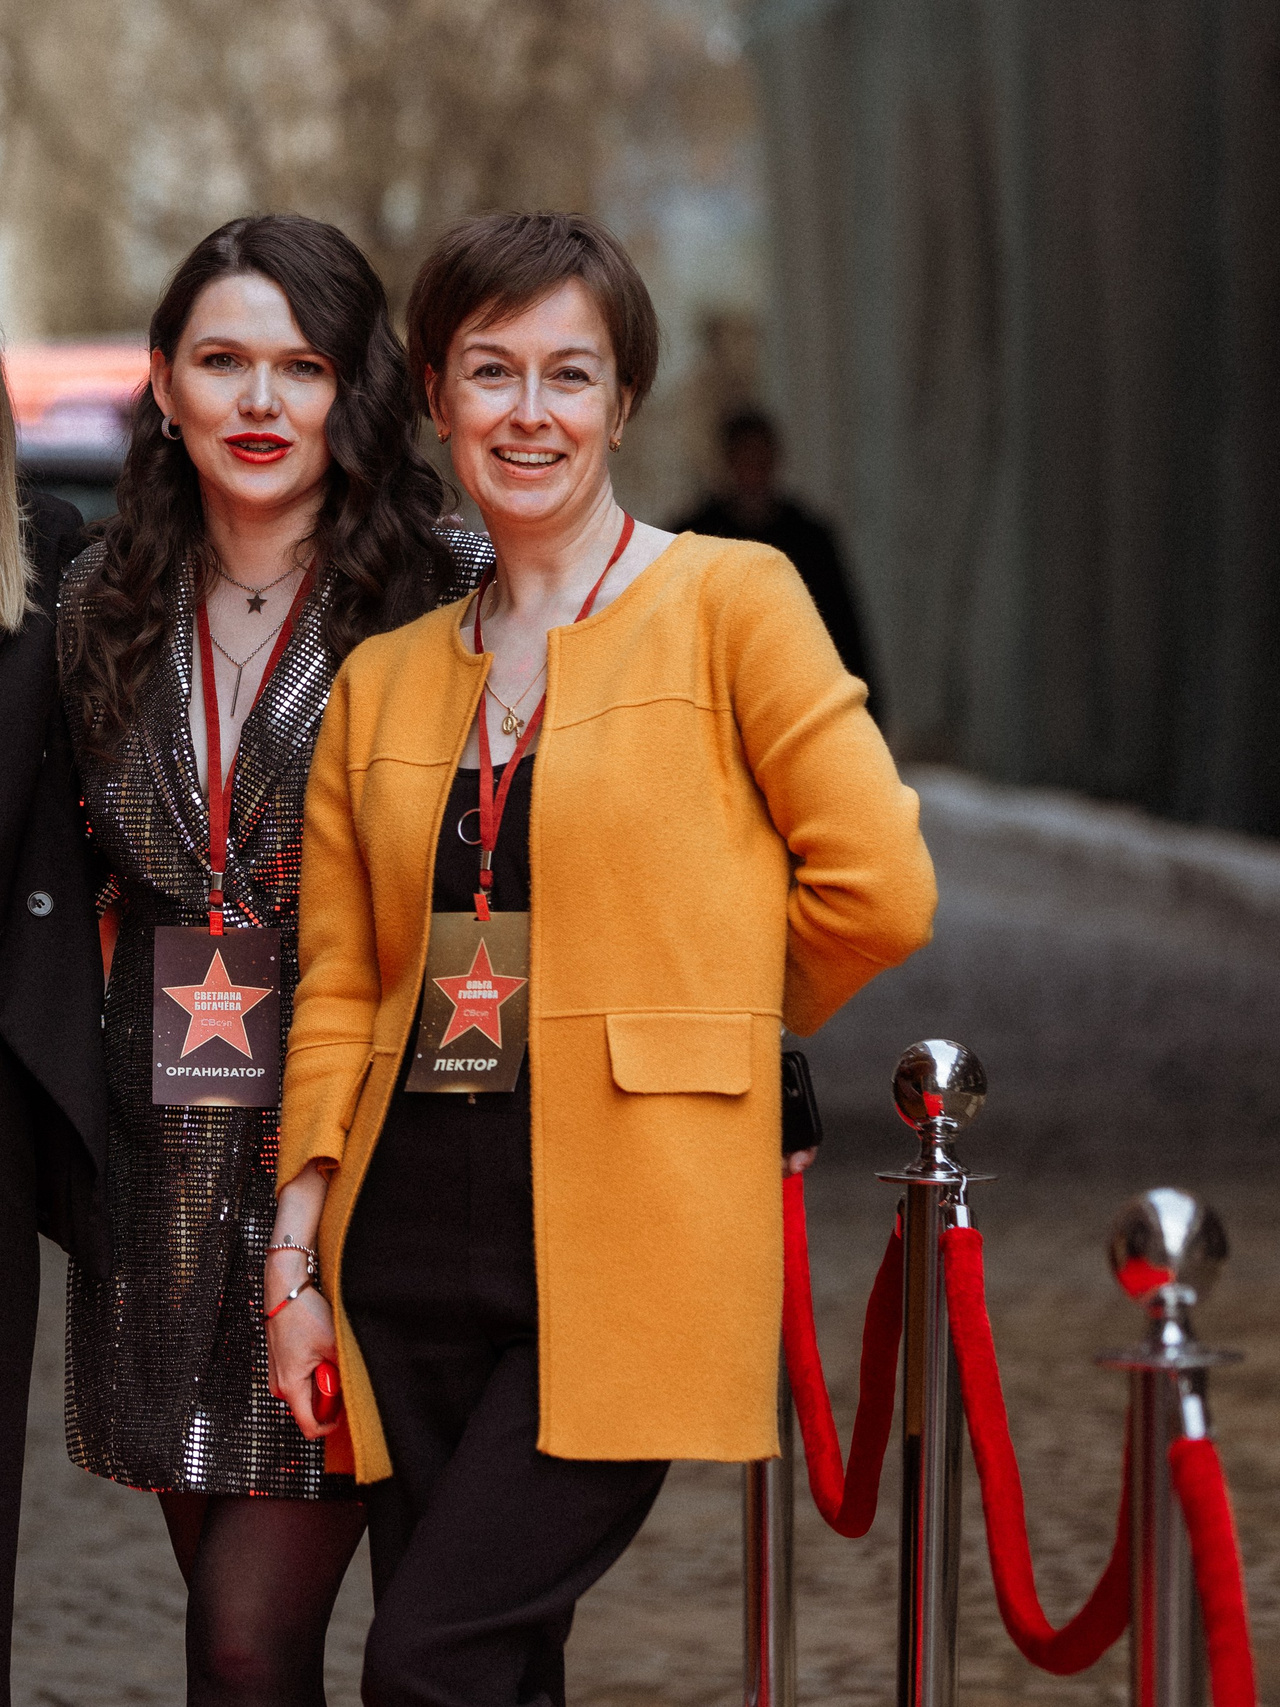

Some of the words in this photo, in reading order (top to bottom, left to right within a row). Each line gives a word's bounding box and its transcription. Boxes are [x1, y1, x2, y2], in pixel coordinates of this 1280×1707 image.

[466, 980, 493, 990] ОЛЬГА
[194, 991, 242, 1001] СВЕТЛАНА
[457, 989, 499, 999] ГУСАРОВА
[194, 1000, 241, 1011] БОГАЧЁВА
[433, 1058, 498, 1072] ЛЕКТОР
[165, 1066, 266, 1078] ОРГАНИЗАТОР
